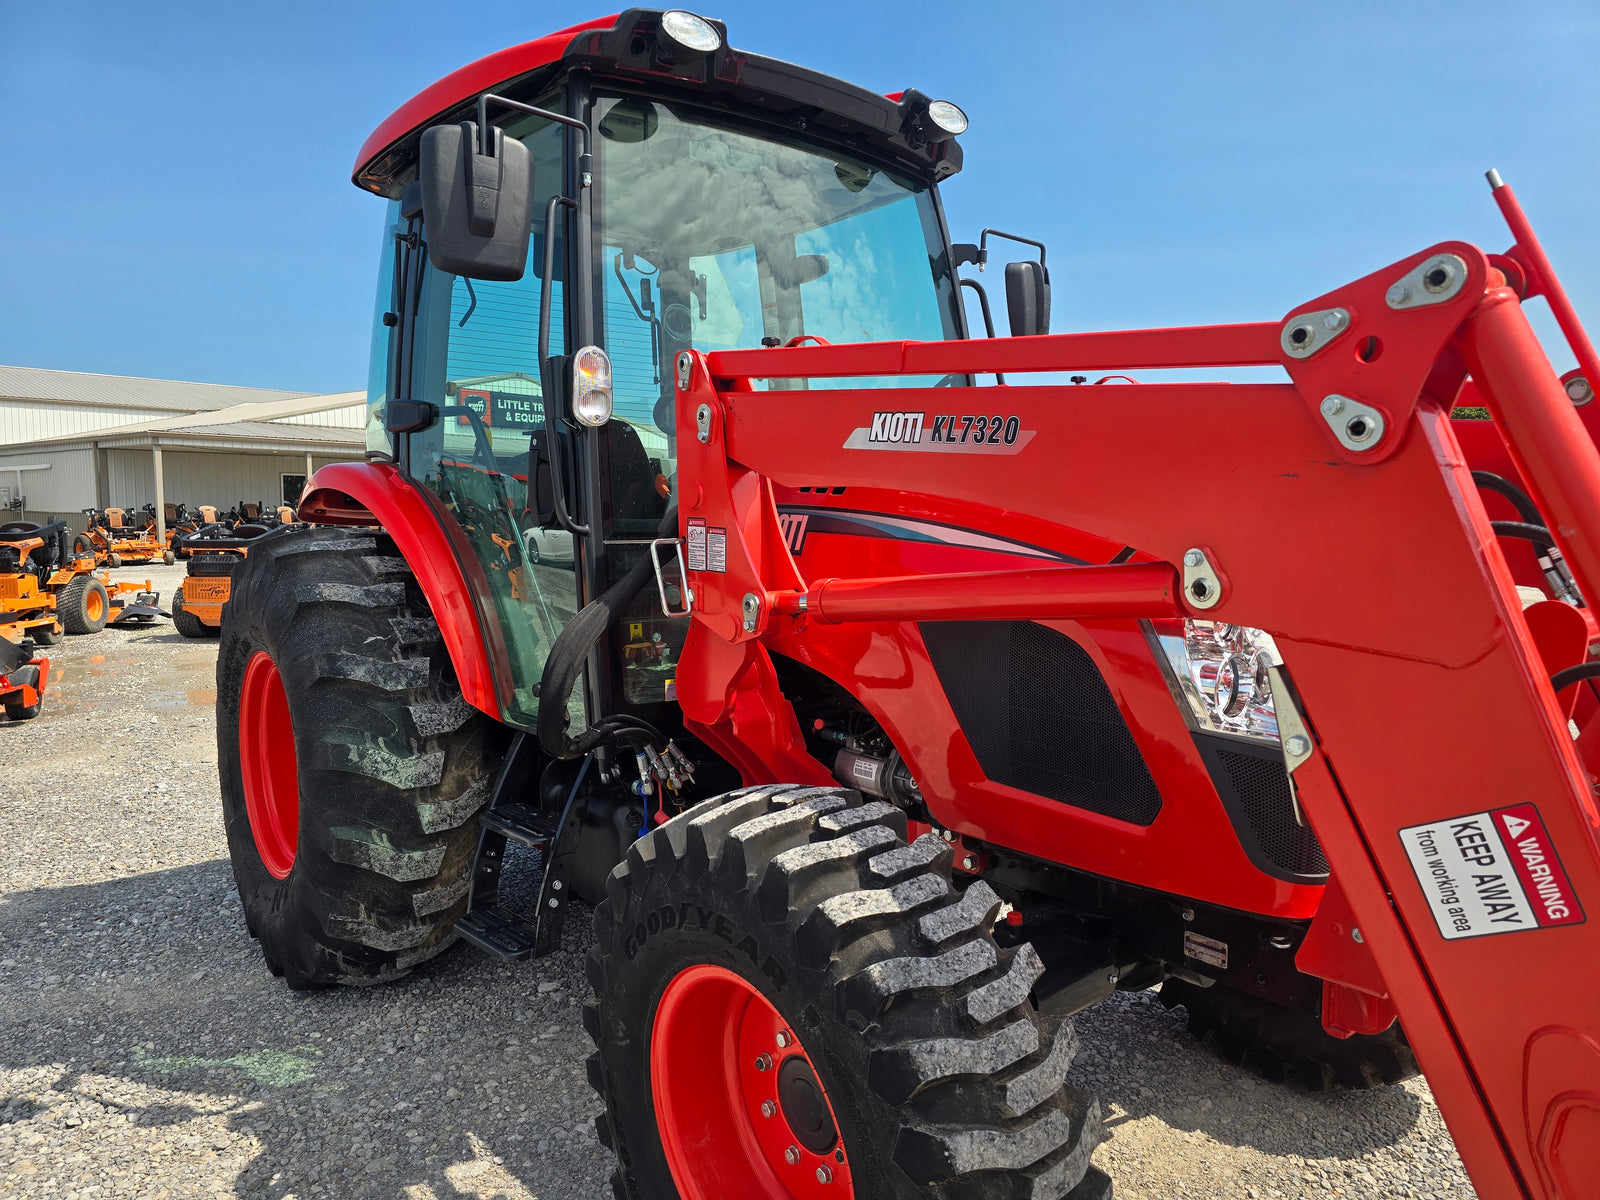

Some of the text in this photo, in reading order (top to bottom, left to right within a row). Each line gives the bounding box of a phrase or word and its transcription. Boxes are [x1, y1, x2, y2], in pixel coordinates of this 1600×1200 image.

[497, 399, 545, 412] LITTLE TR
[505, 411, 512, 421] &
[869, 411, 1021, 446] KIOTI KL7320
[779, 513, 809, 551] OTI
[1415, 829, 1472, 932] from working area
[1450, 820, 1523, 924] KEEP AWAY
[1517, 836, 1570, 920] WARNING
